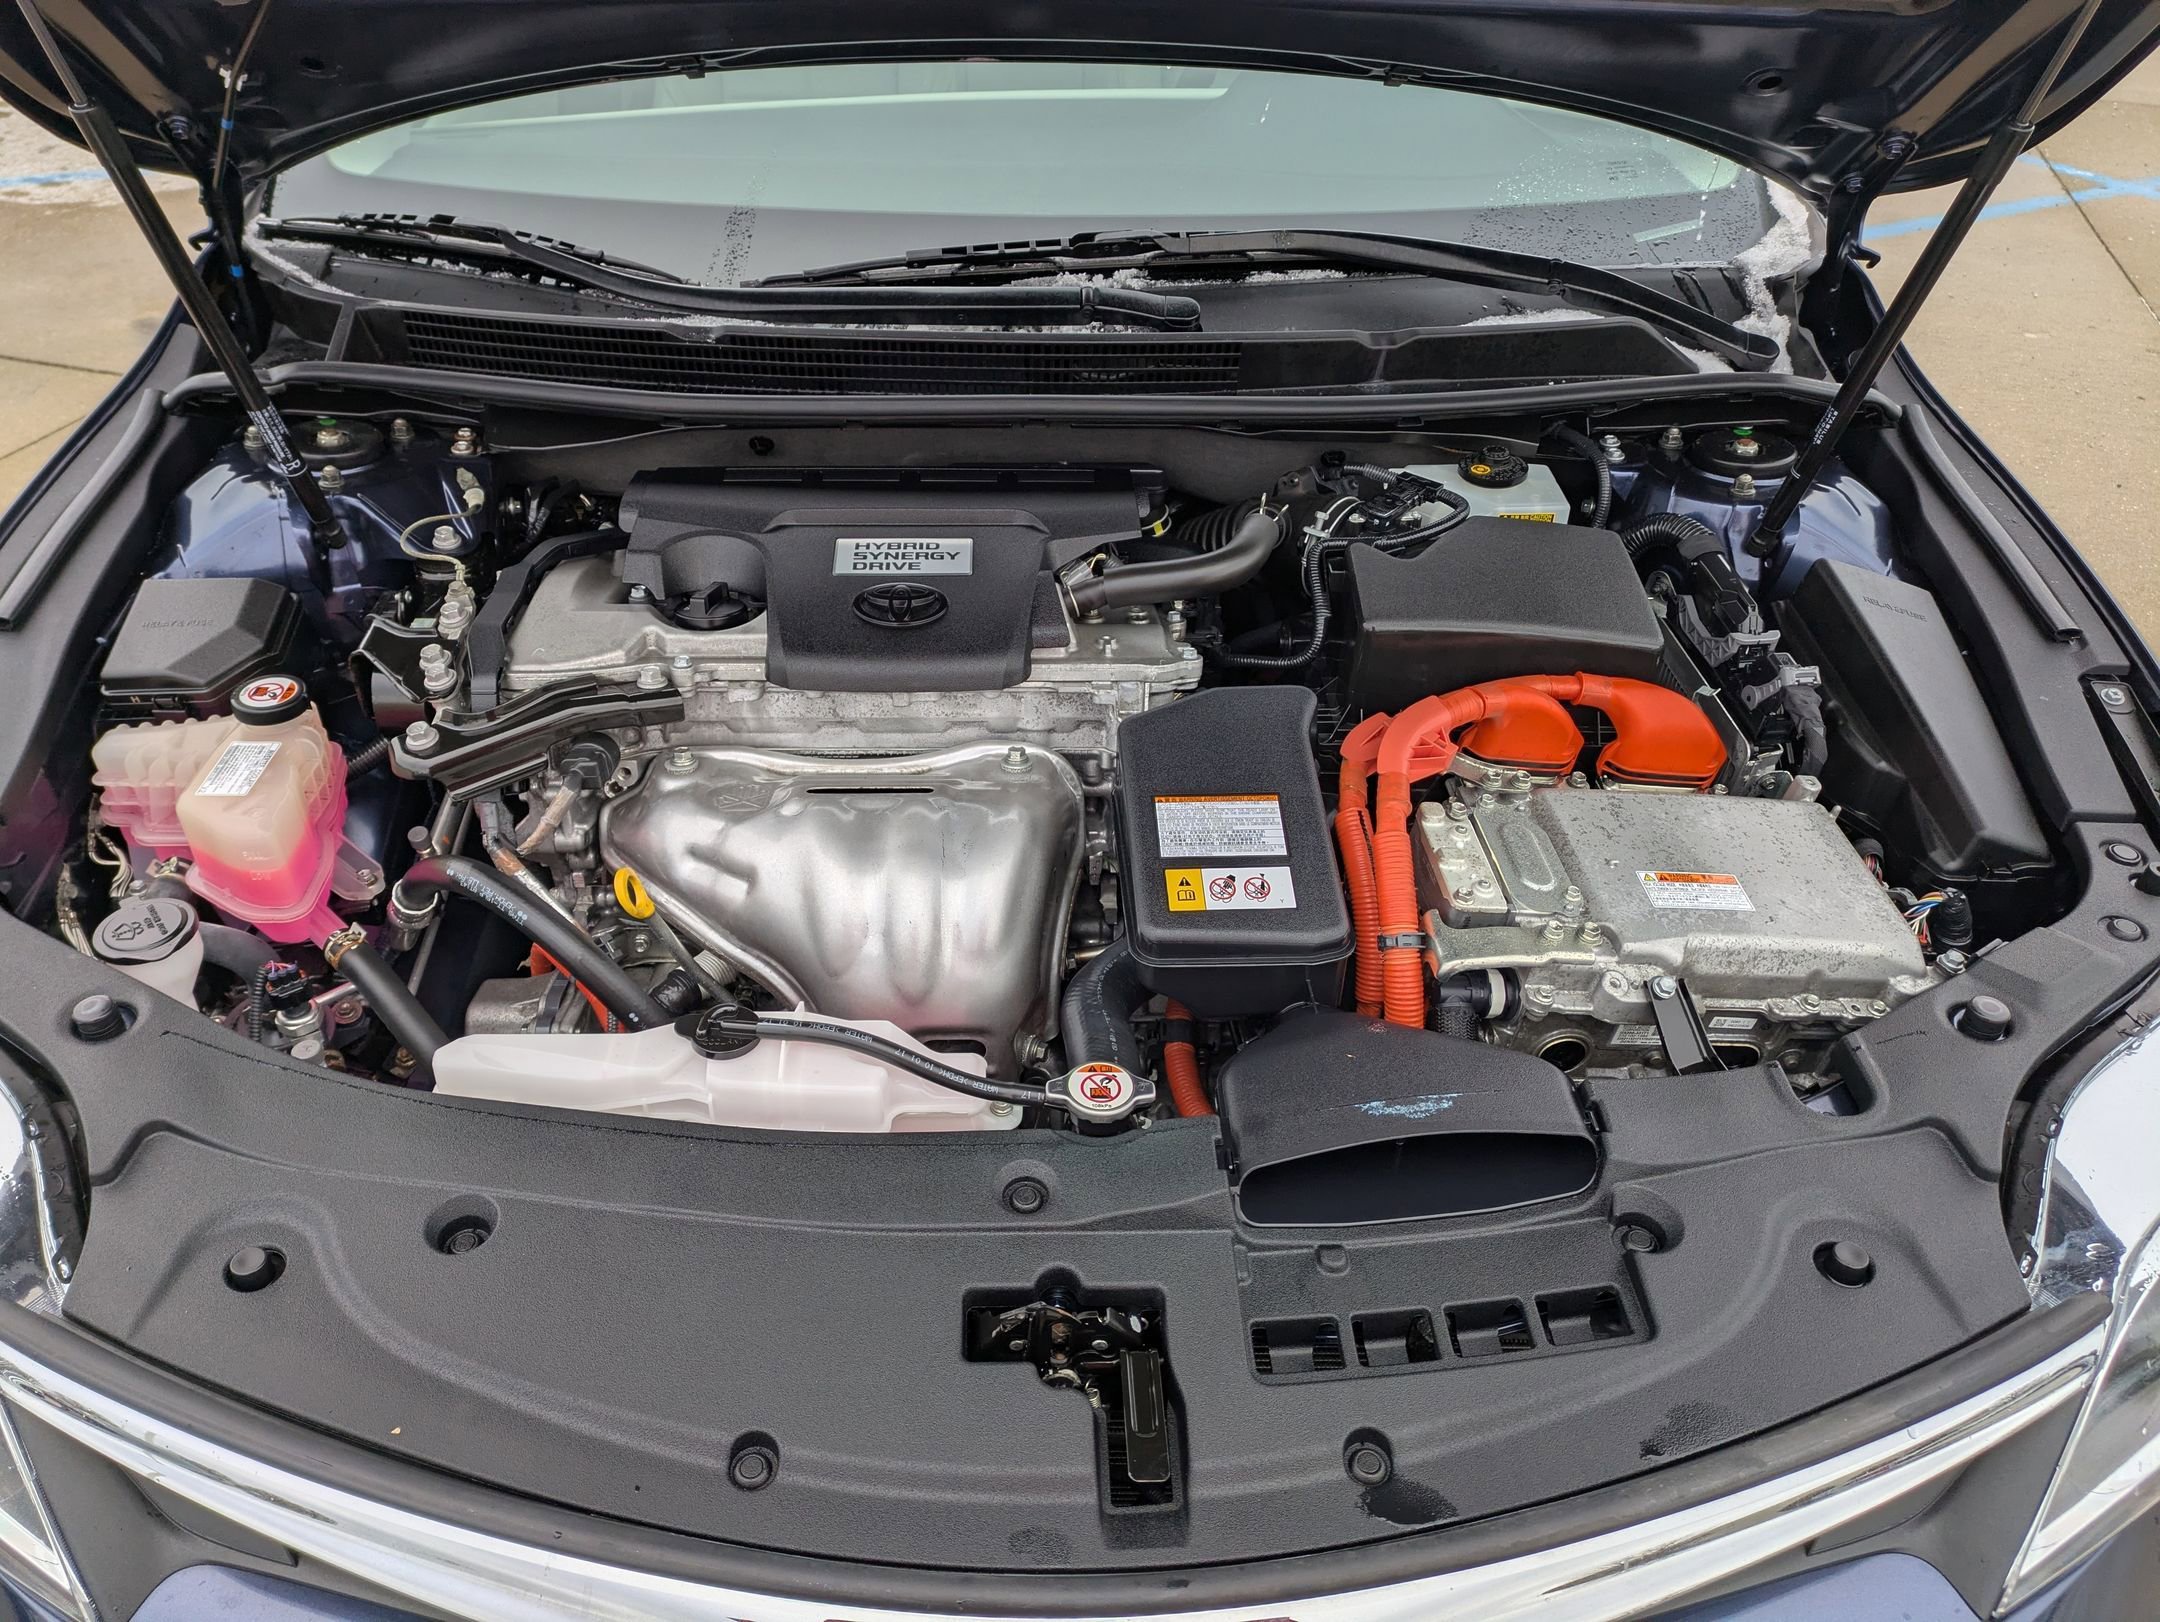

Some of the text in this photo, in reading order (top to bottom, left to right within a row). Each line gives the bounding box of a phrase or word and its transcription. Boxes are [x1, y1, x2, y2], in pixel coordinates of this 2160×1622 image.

[286, 459, 301, 471] R
[854, 542, 940, 550] HYBRID
[853, 551, 961, 560] SYNERGY
[852, 561, 922, 571] DRIVE
[844, 1029, 873, 1043] WATER
[894, 1048, 905, 1057] 17
[911, 1055, 921, 1064] 01
[924, 1061, 934, 1071] 10
[972, 1080, 999, 1094] WATER
[1021, 1091, 1031, 1099] 17
